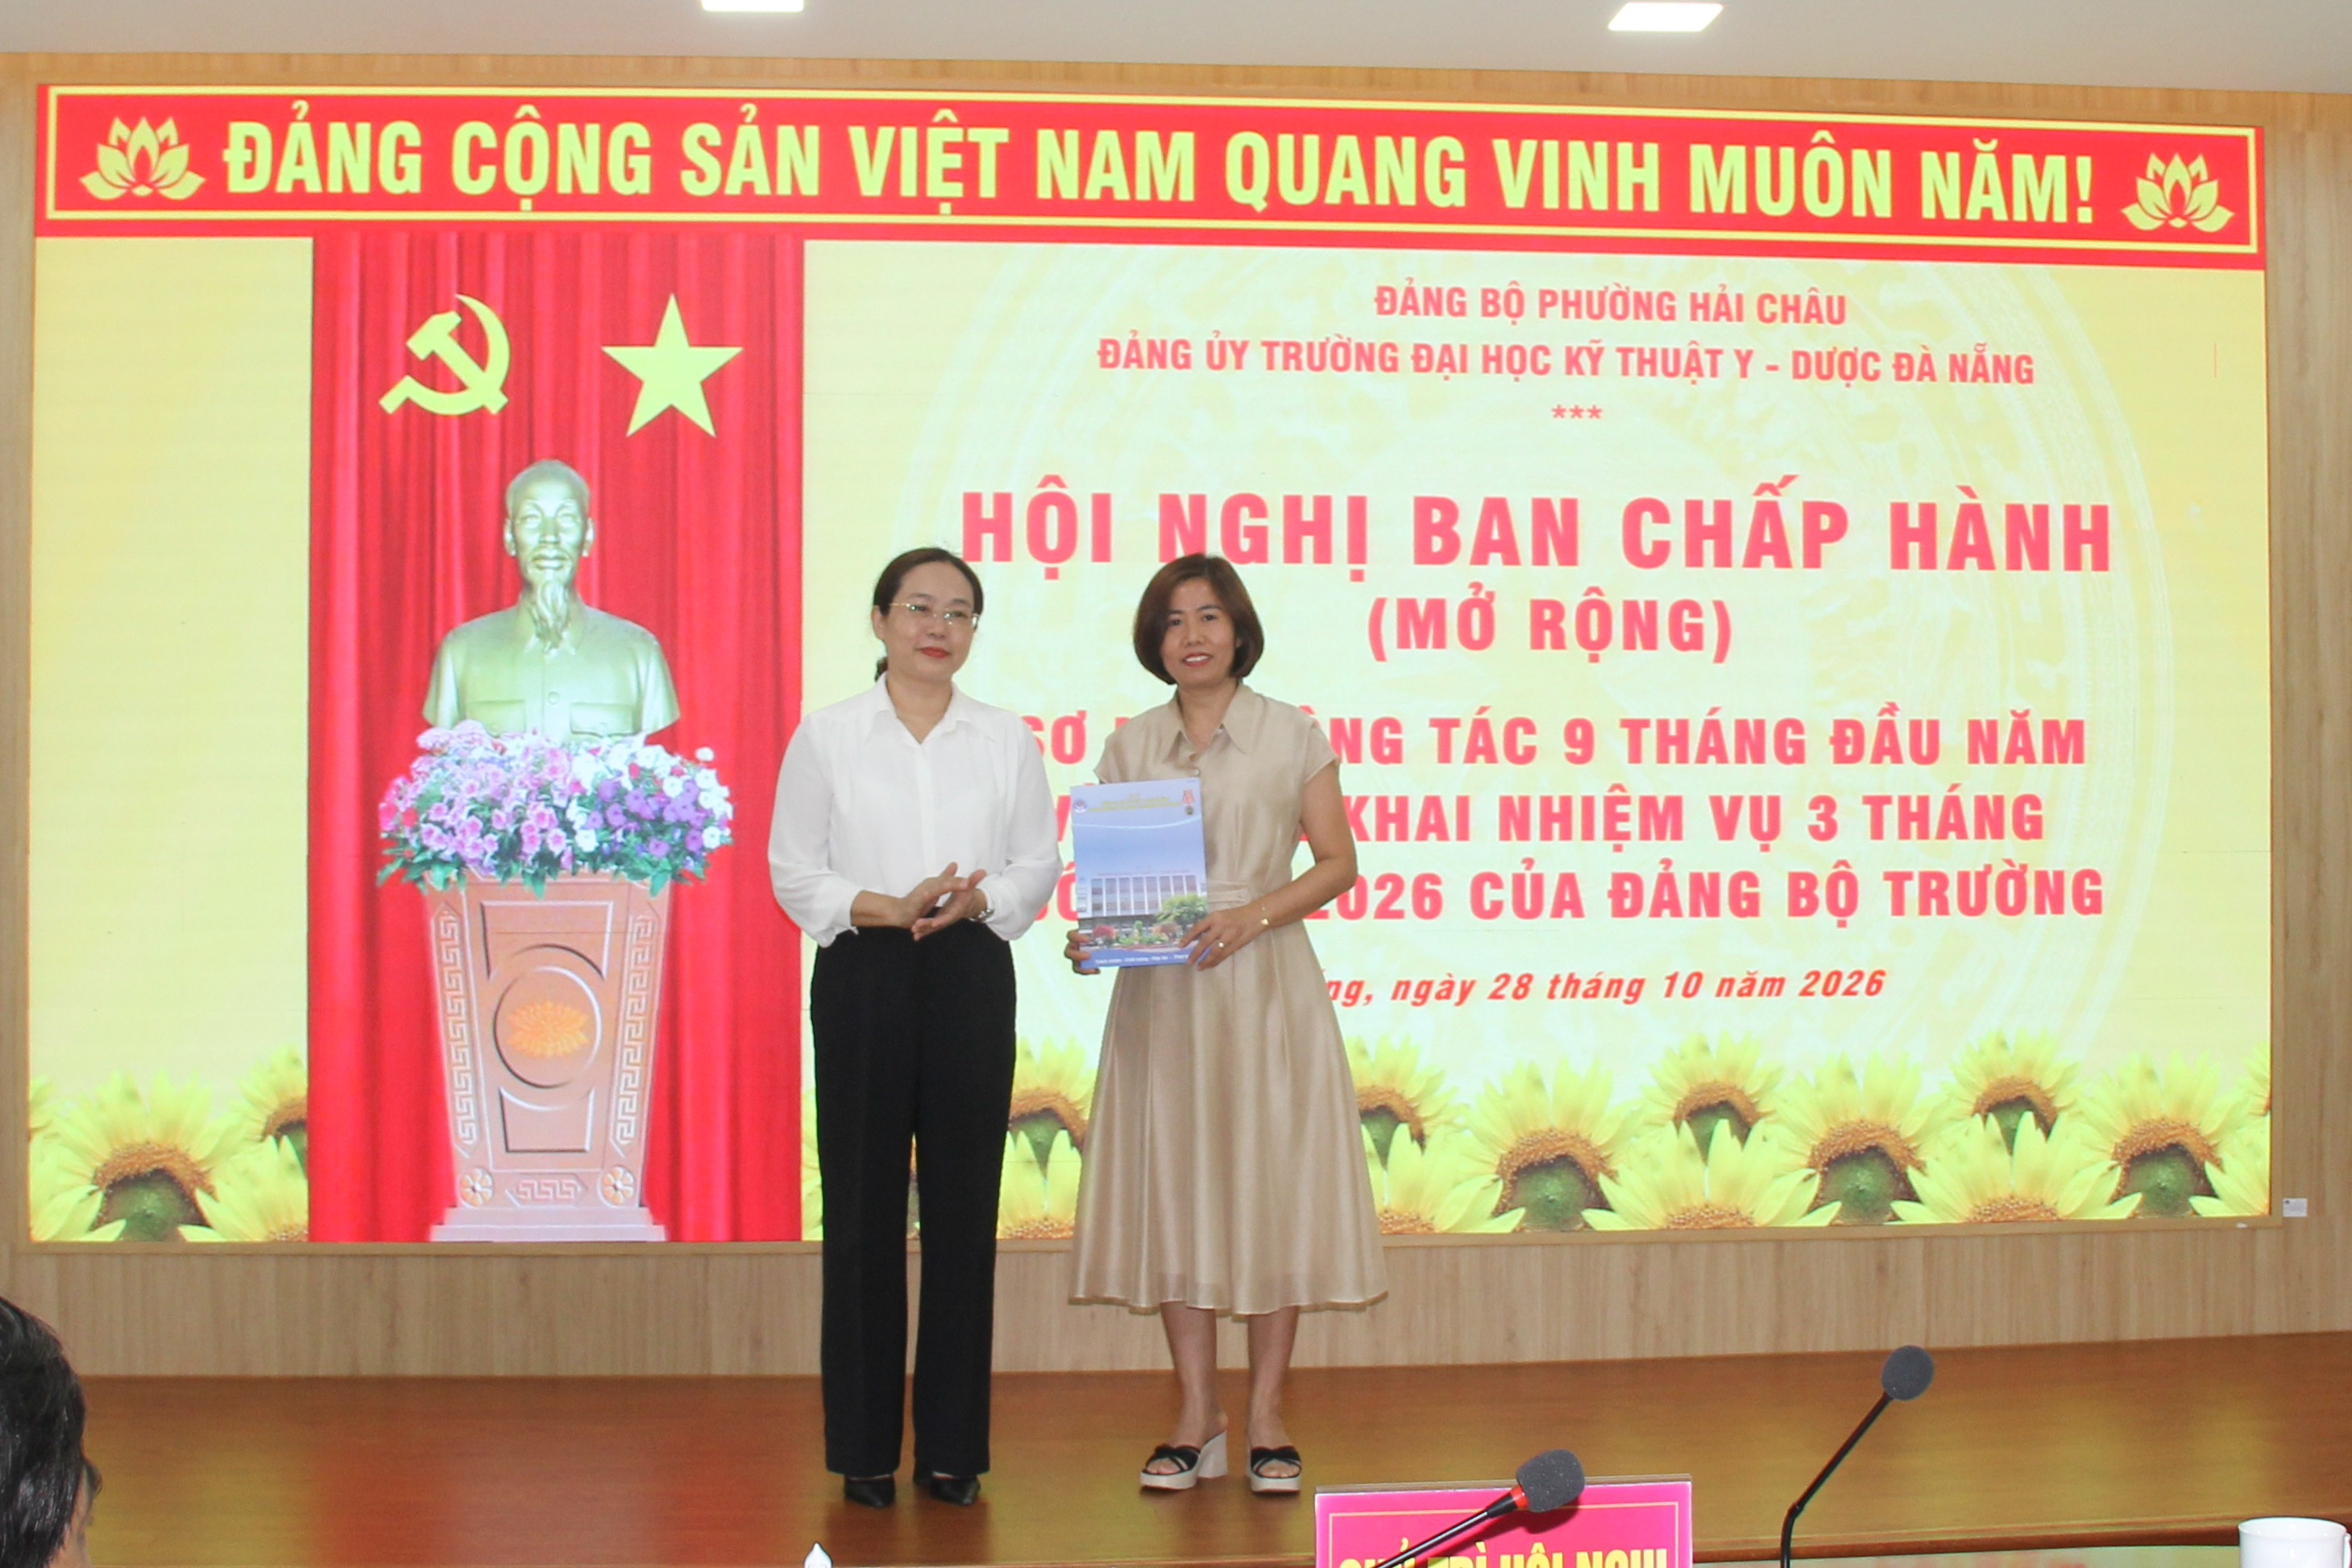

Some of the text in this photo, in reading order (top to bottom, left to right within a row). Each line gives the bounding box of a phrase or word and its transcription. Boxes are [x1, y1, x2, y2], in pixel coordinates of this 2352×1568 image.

[223, 100, 2093, 224] ĐẢNG CỘNG SẢN VIỆT NAM QUANG VINH MUÔN NĂM!
[1375, 277, 1848, 326] ĐẢNG BỘ PHƯỜNG HẢI CHÂU
[1097, 329, 1193, 371] ĐẢNG
[1205, 330, 1251, 371] ỦY
[1260, 334, 1400, 374] TRƯỜNG
[1410, 343, 1470, 381] ĐẠI
[1482, 343, 1552, 382] HỌC
[1565, 339, 1605, 377] KỸ
[1616, 340, 1724, 385] THUẬT
[1734, 348, 1755, 379] Y
[1791, 346, 1882, 388] DƯỢC
[1892, 344, 1939, 384] ĐÀ
[1948, 342, 2035, 385] NẴNG
[962, 474, 2111, 583] HỘI NGHỊ BAN CHẤP HÀNH
[1368, 581, 1732, 664] (MỞ RỘNG)
[1428, 705, 1538, 765] TÁC
[1563, 717, 1595, 765] 9
[1620, 706, 1807, 765] THÁNG
[1827, 701, 1942, 765] ĐẦU
[1967, 708, 2086, 765] NĂM
[1499, 782, 1684, 852] NHIỆM
[1708, 794, 1782, 852] VỤ
[1808, 794, 1839, 842] 3
[1861, 782, 2045, 841] THÁNG
[1470, 857, 1586, 921] CỦA
[1607, 857, 1761, 919] ĐẢNG
[1787, 858, 1860, 929] BỘ
[1882, 857, 2104, 918] TRƯỜNG
[1390, 973, 1477, 1007] ngày
[1487, 973, 1535, 1001] 28
[1546, 971, 1647, 1006] tháng
[1664, 970, 1705, 999] 10
[1715, 971, 1787, 998] năm
[1798, 969, 1888, 998] 2026
